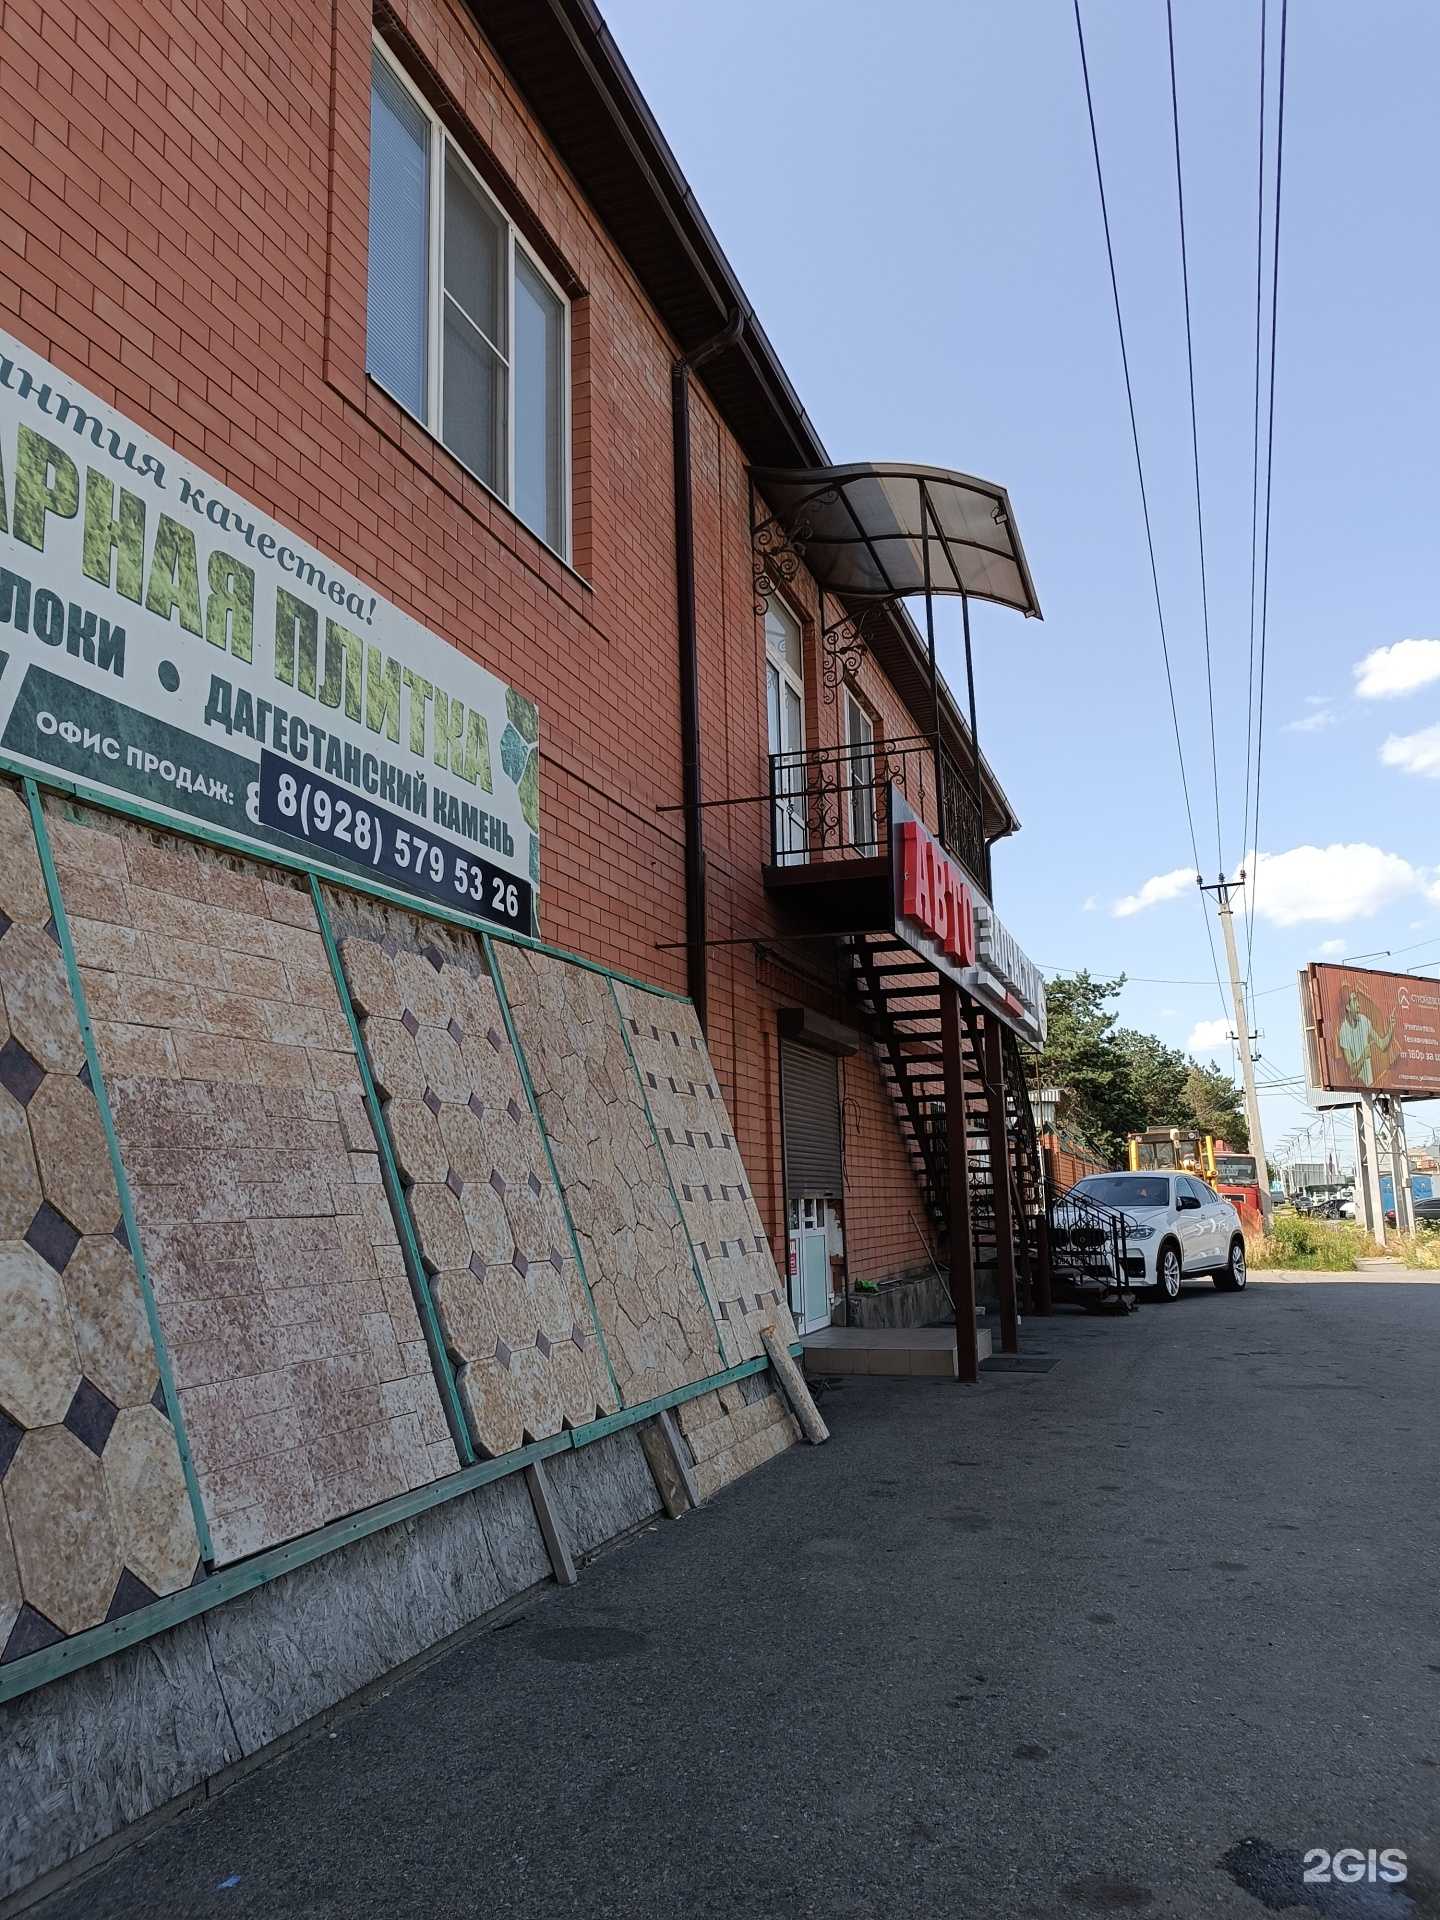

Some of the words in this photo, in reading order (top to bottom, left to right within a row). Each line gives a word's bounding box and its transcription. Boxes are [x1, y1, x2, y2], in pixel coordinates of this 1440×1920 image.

[0, 421, 256, 665] РНАЯ
[274, 585, 494, 795] ПЛИТКА
[178, 477, 377, 627] качества!
[36, 711, 121, 760] ОФИС
[126, 744, 235, 806] ПРОДАЖ:
[204, 673, 428, 818] ДАГЕСТАНСКИЙ
[432, 787, 515, 858] КАМЕНЬ
[277, 773, 383, 866] 8(928)
[394, 829, 445, 883] 579
[454, 857, 484, 902] 53
[492, 877, 520, 917] 26
[904, 821, 977, 968] АВТО
